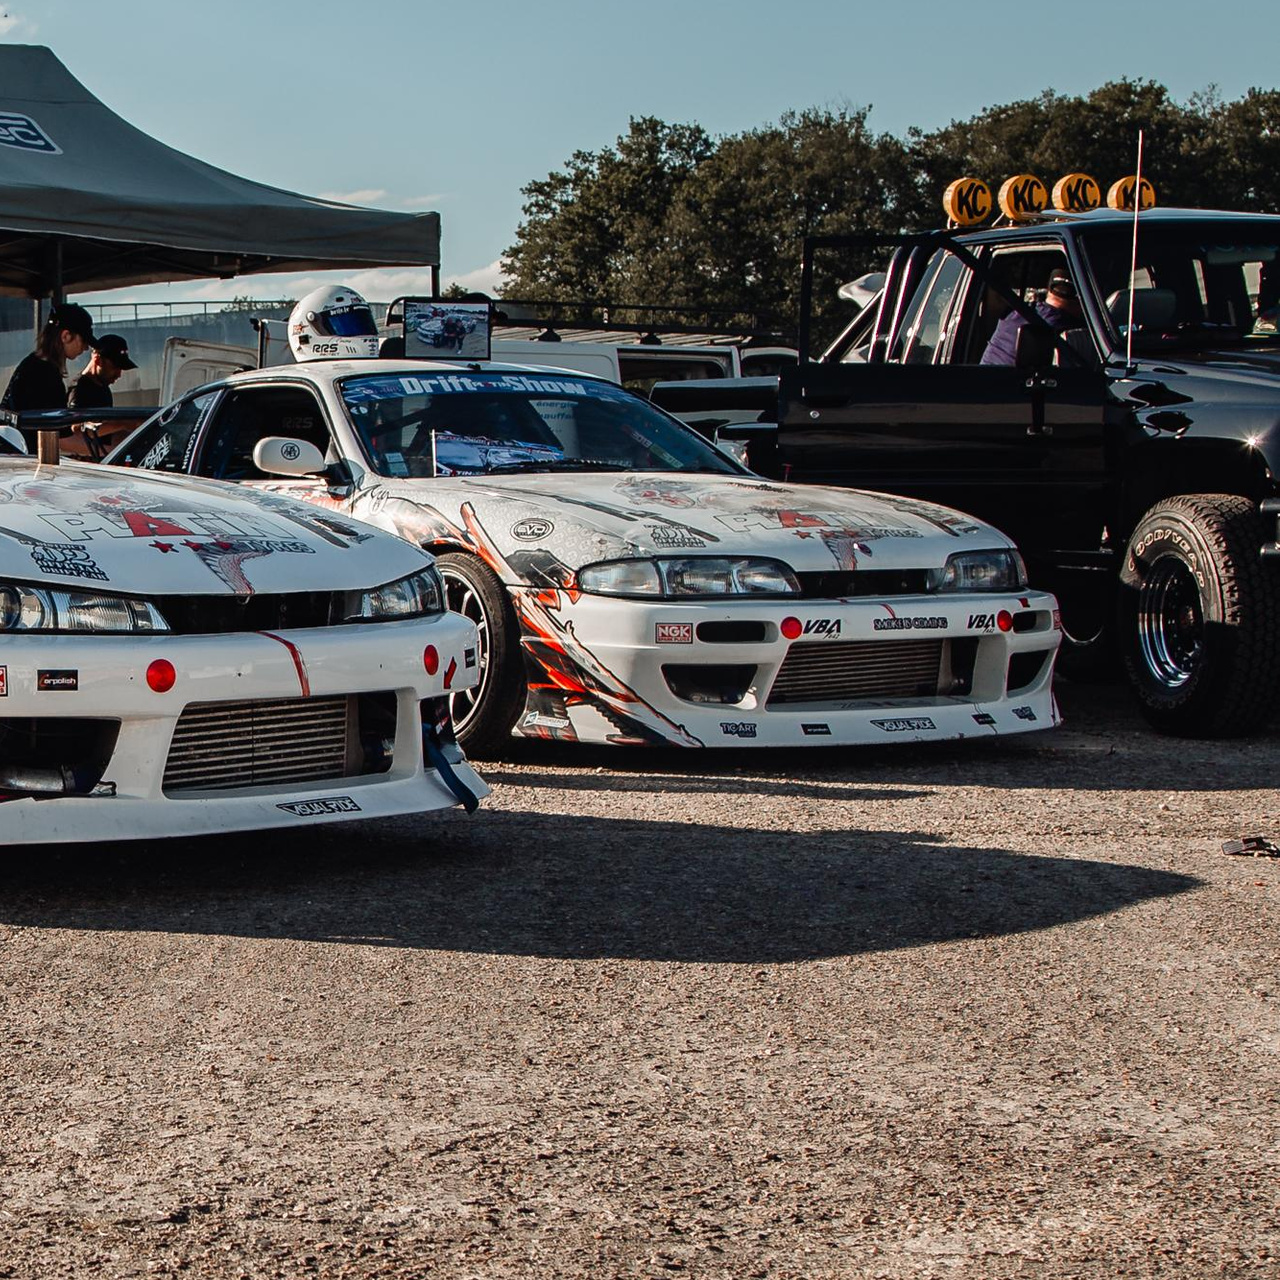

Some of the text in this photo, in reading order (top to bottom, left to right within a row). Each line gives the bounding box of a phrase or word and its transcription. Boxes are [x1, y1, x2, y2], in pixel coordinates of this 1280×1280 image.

[958, 182, 987, 219] KC
[1012, 178, 1043, 212] KC
[1066, 177, 1098, 213] KC
[1122, 179, 1153, 210] KC
[312, 344, 339, 353] RRS
[398, 375, 478, 395] Drift
[501, 375, 587, 395] Show
[237, 540, 317, 553] TYRES
[802, 619, 842, 634] VBA
[967, 614, 996, 629] VBA
[657, 626, 690, 637] NGK
